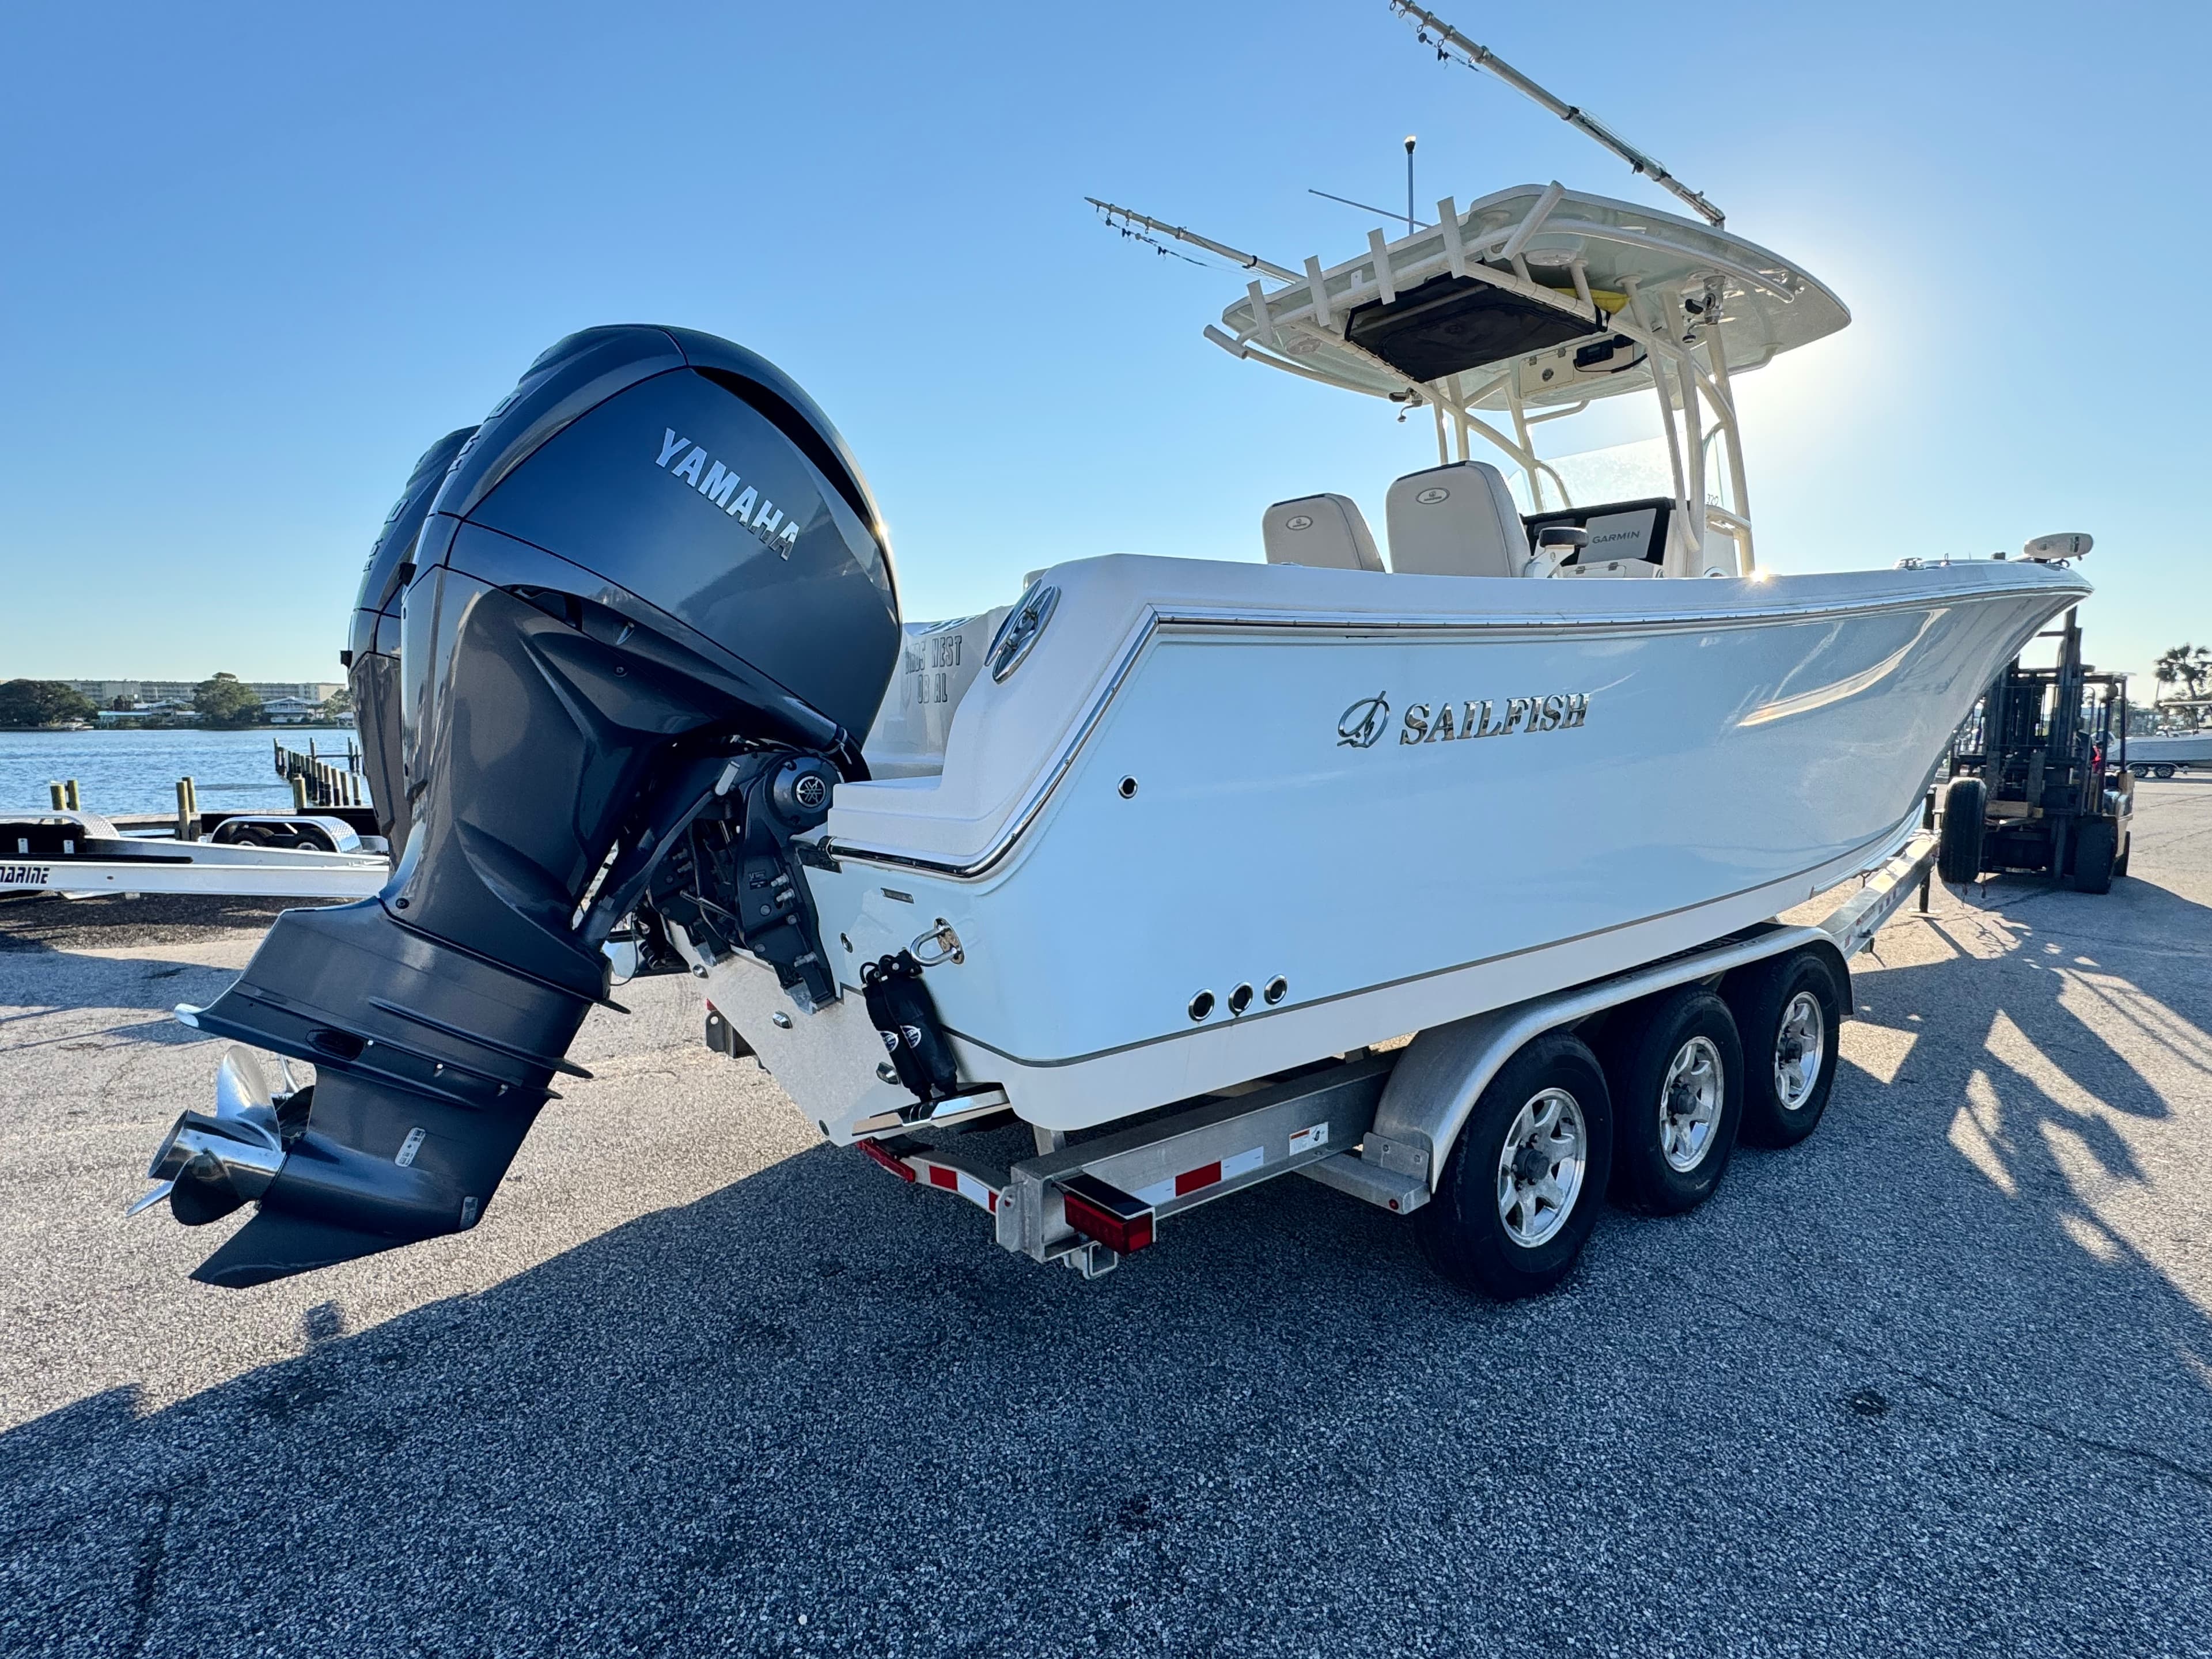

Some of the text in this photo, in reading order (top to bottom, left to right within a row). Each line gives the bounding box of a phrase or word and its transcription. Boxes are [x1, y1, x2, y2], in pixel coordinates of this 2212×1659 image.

[656, 428, 800, 560] YAMAHA
[1592, 530, 1641, 544] GARMIN
[932, 635, 962, 668] NEST
[918, 673, 948, 704] OB AL
[1400, 692, 1592, 745] SAILFISH
